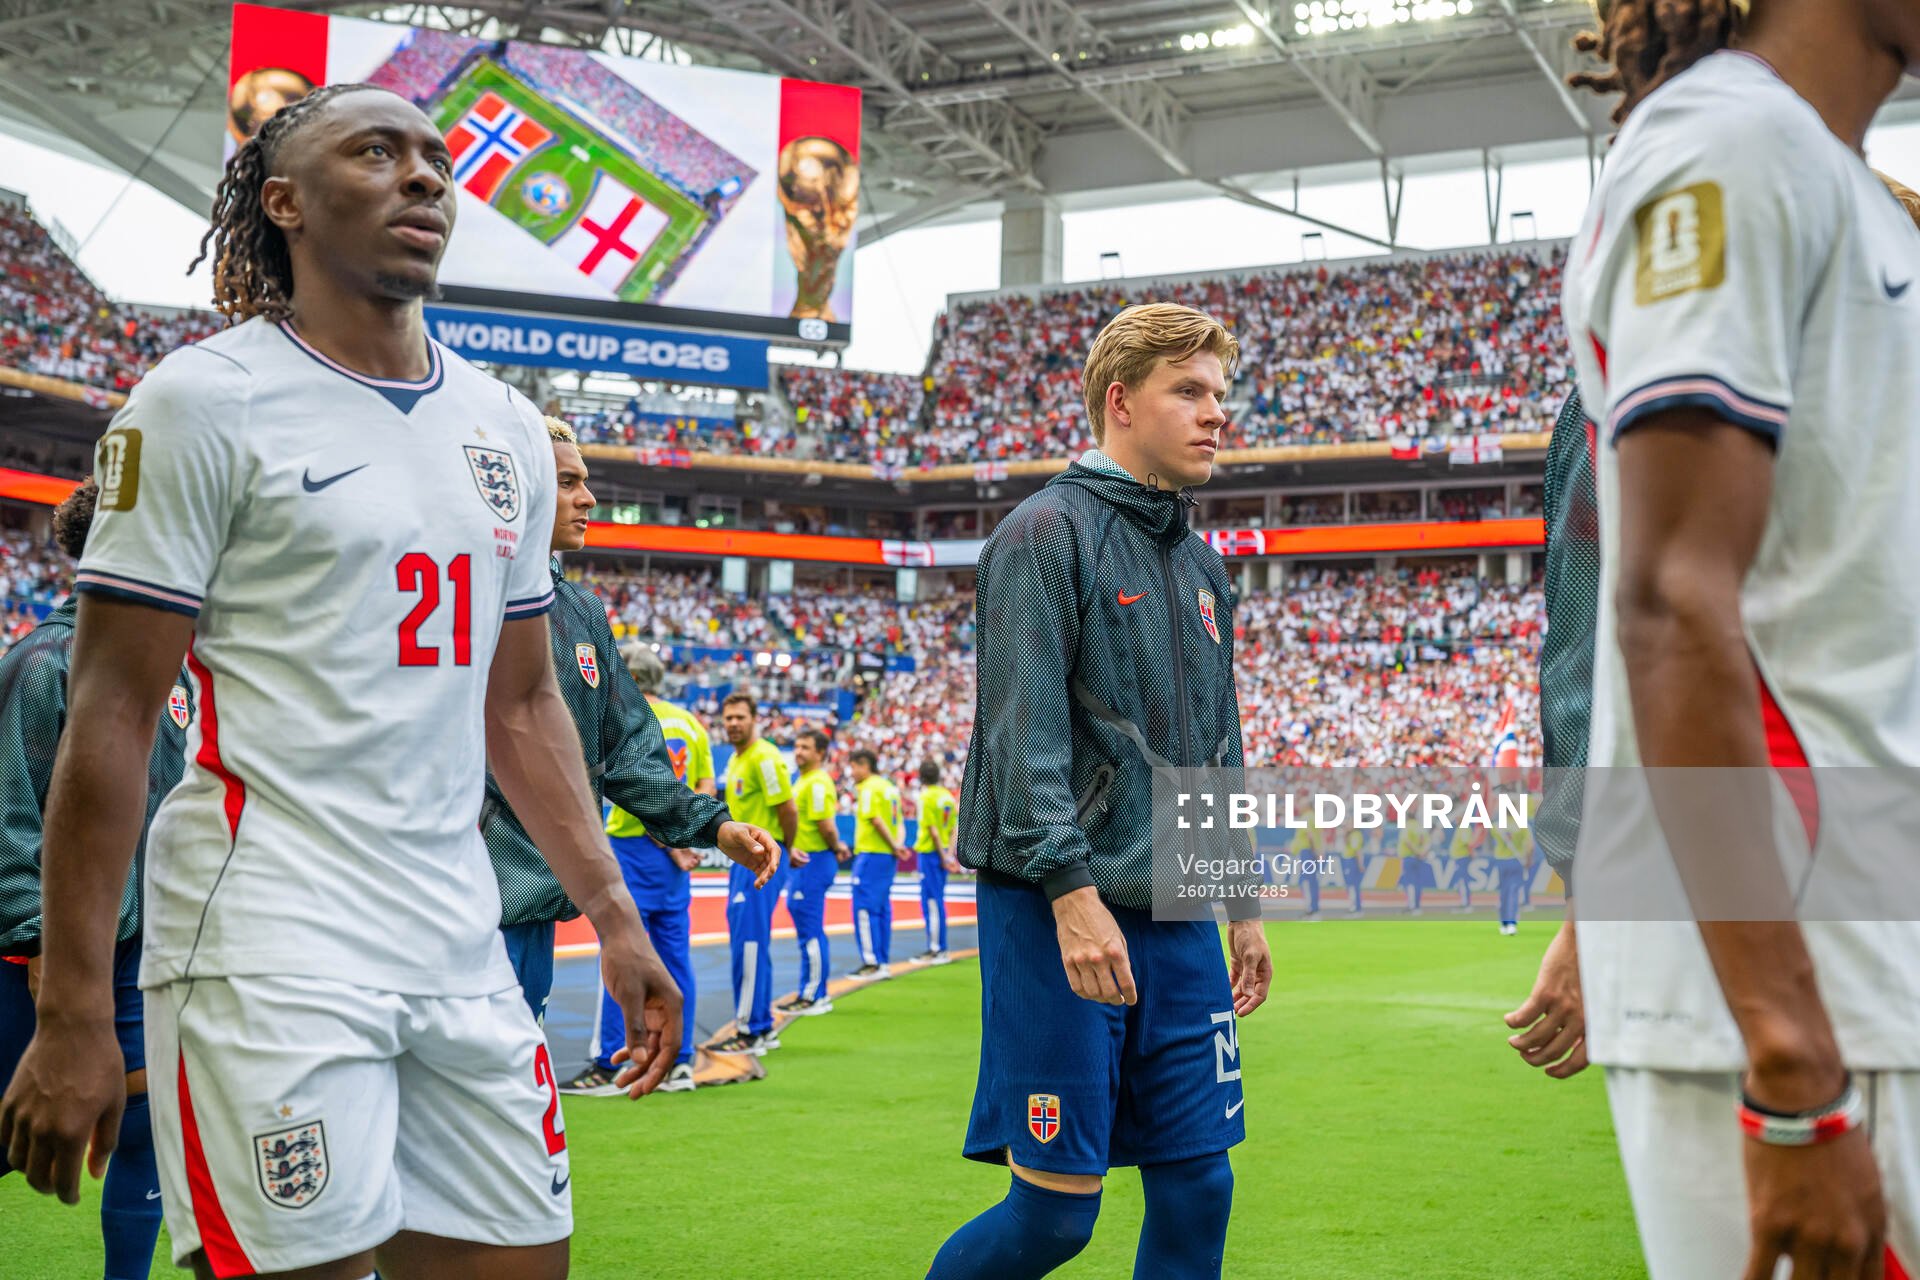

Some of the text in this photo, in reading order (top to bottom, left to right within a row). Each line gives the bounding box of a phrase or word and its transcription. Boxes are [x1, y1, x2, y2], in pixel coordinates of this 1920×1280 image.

[437, 319, 551, 356] WORLD
[556, 331, 620, 362] CUP
[622, 337, 731, 373] 2026
[396, 552, 471, 667] 21
